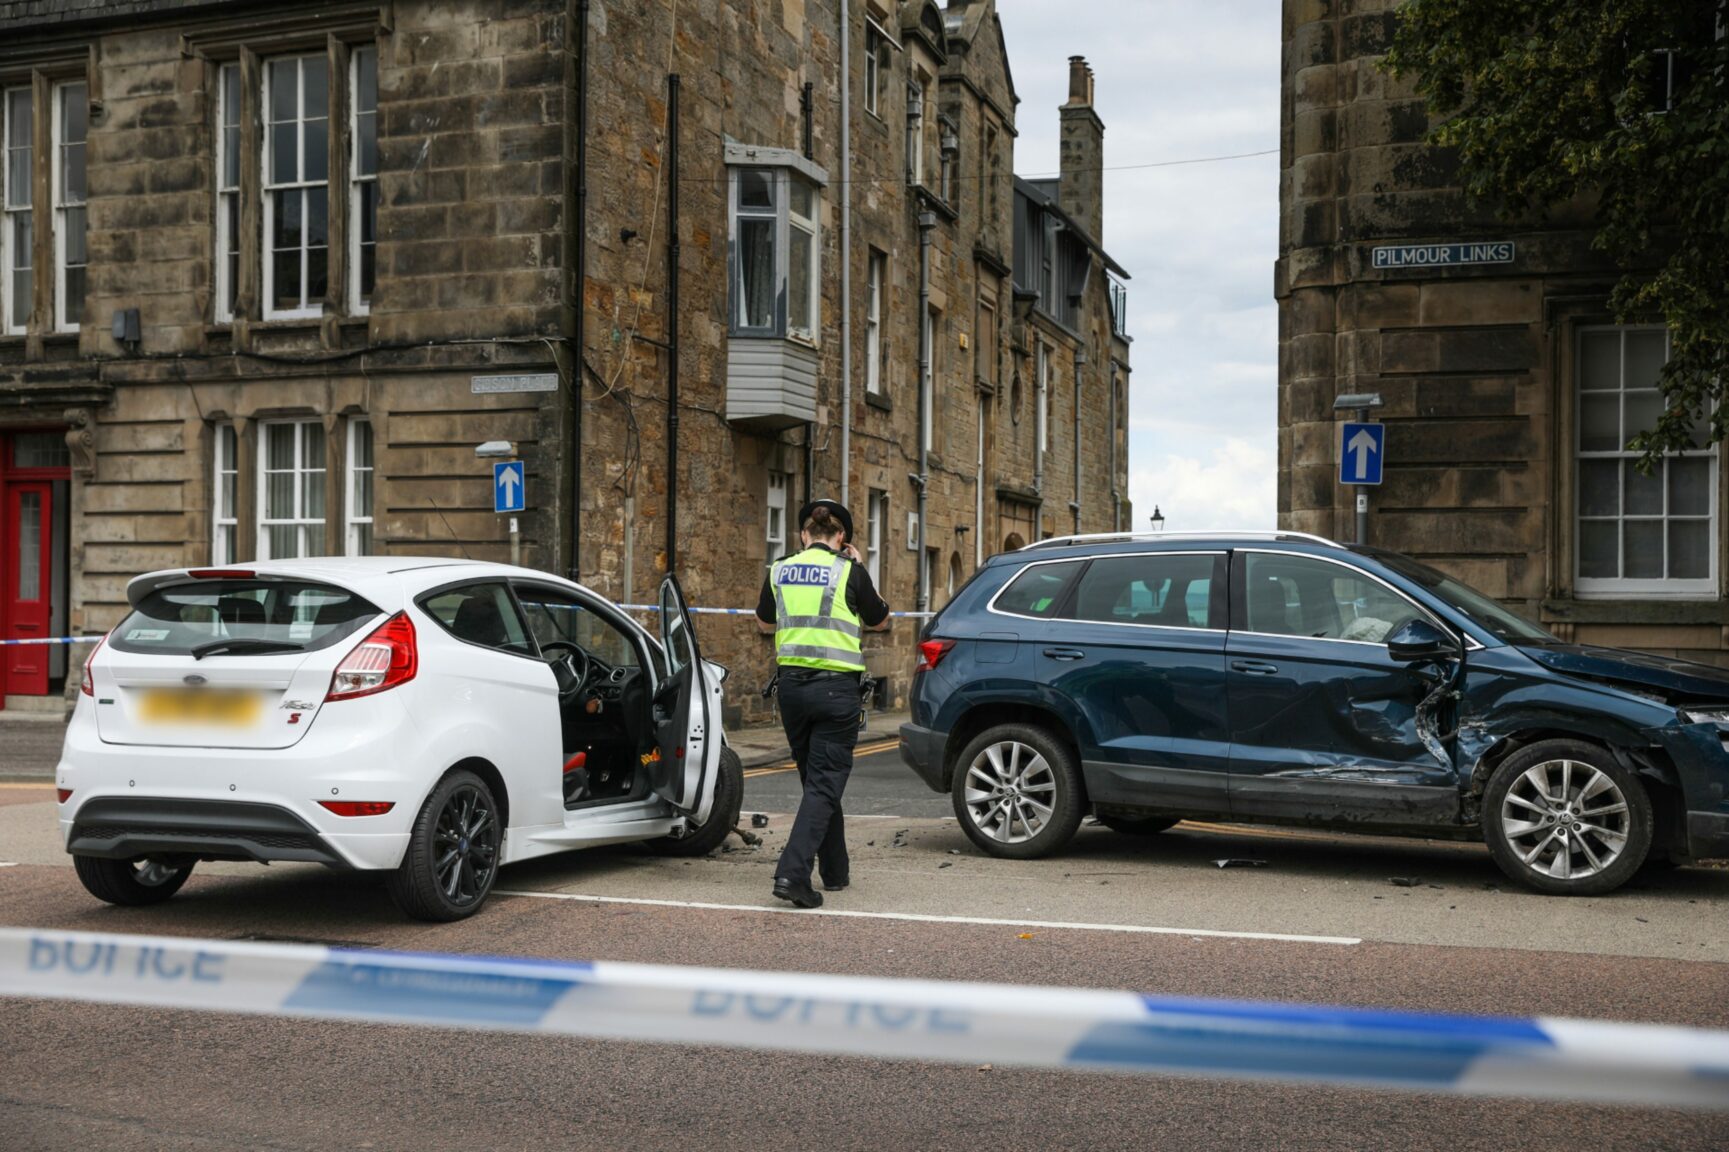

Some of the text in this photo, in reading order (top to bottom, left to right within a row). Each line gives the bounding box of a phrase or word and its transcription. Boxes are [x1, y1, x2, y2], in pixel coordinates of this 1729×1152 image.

[1377, 244, 1509, 265] PILMOUR LINKS
[780, 566, 829, 583] POLICE
